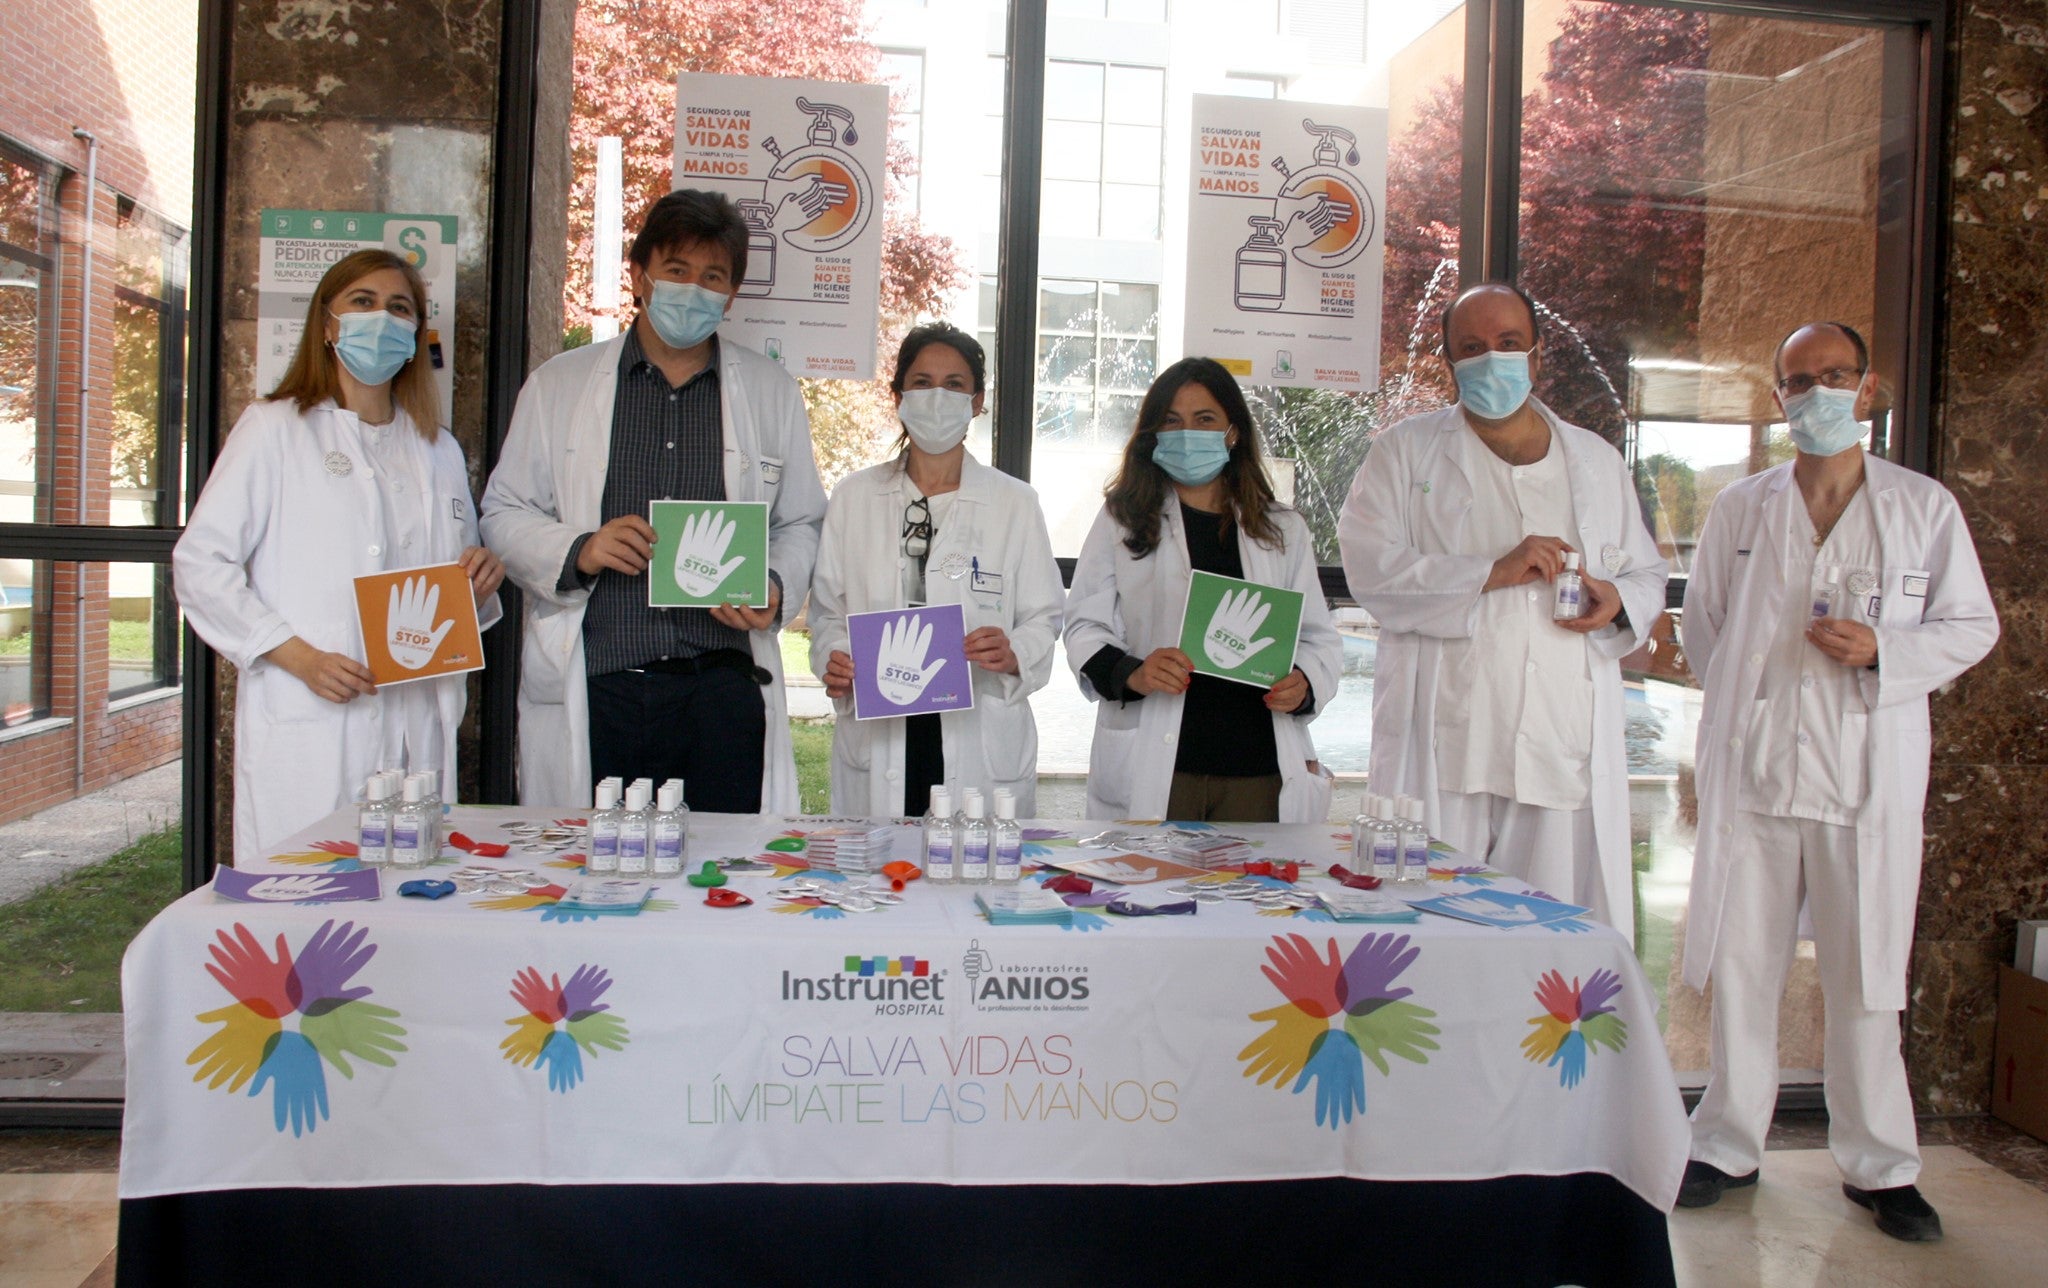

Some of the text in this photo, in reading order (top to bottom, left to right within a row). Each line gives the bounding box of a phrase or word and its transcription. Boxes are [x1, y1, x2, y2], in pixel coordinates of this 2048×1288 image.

[686, 107, 731, 116] SEGUNDOS
[686, 115, 751, 131] SALVAN
[1201, 127, 1243, 136] SEGUNDOS
[685, 130, 750, 149] VIDAS
[1200, 136, 1261, 151] SALVAN
[1200, 150, 1260, 169] VIDAS
[684, 159, 748, 175] MANOS
[1199, 177, 1260, 194] MANOS
[275, 247, 321, 261] PEDIR
[286, 261, 322, 269] ATENCIÓN
[815, 264, 851, 273] GUANTES
[274, 270, 303, 278] NUNCA
[304, 271, 319, 279] FUE
[814, 273, 851, 284] NO ES
[813, 284, 850, 292] HIGIENE
[1321, 280, 1356, 288] GUANTES
[824, 292, 850, 300] MANOS
[1321, 288, 1355, 298] NO ES
[1320, 298, 1355, 307] HIGIENE
[1338, 369, 1361, 377] VIDAS,
[684, 558, 718, 576] STOP
[395, 631, 431, 645] STOP
[1214, 629, 1247, 650] STOP
[885, 667, 920, 682] STOP
[979, 976, 1090, 1001] ANIOS
[875, 1003, 945, 1016] HOSPITAL
[782, 1034, 1083, 1079] SALVA VIDAS,
[688, 1073, 1178, 1124] LÍMPIATE LAS MANOS
